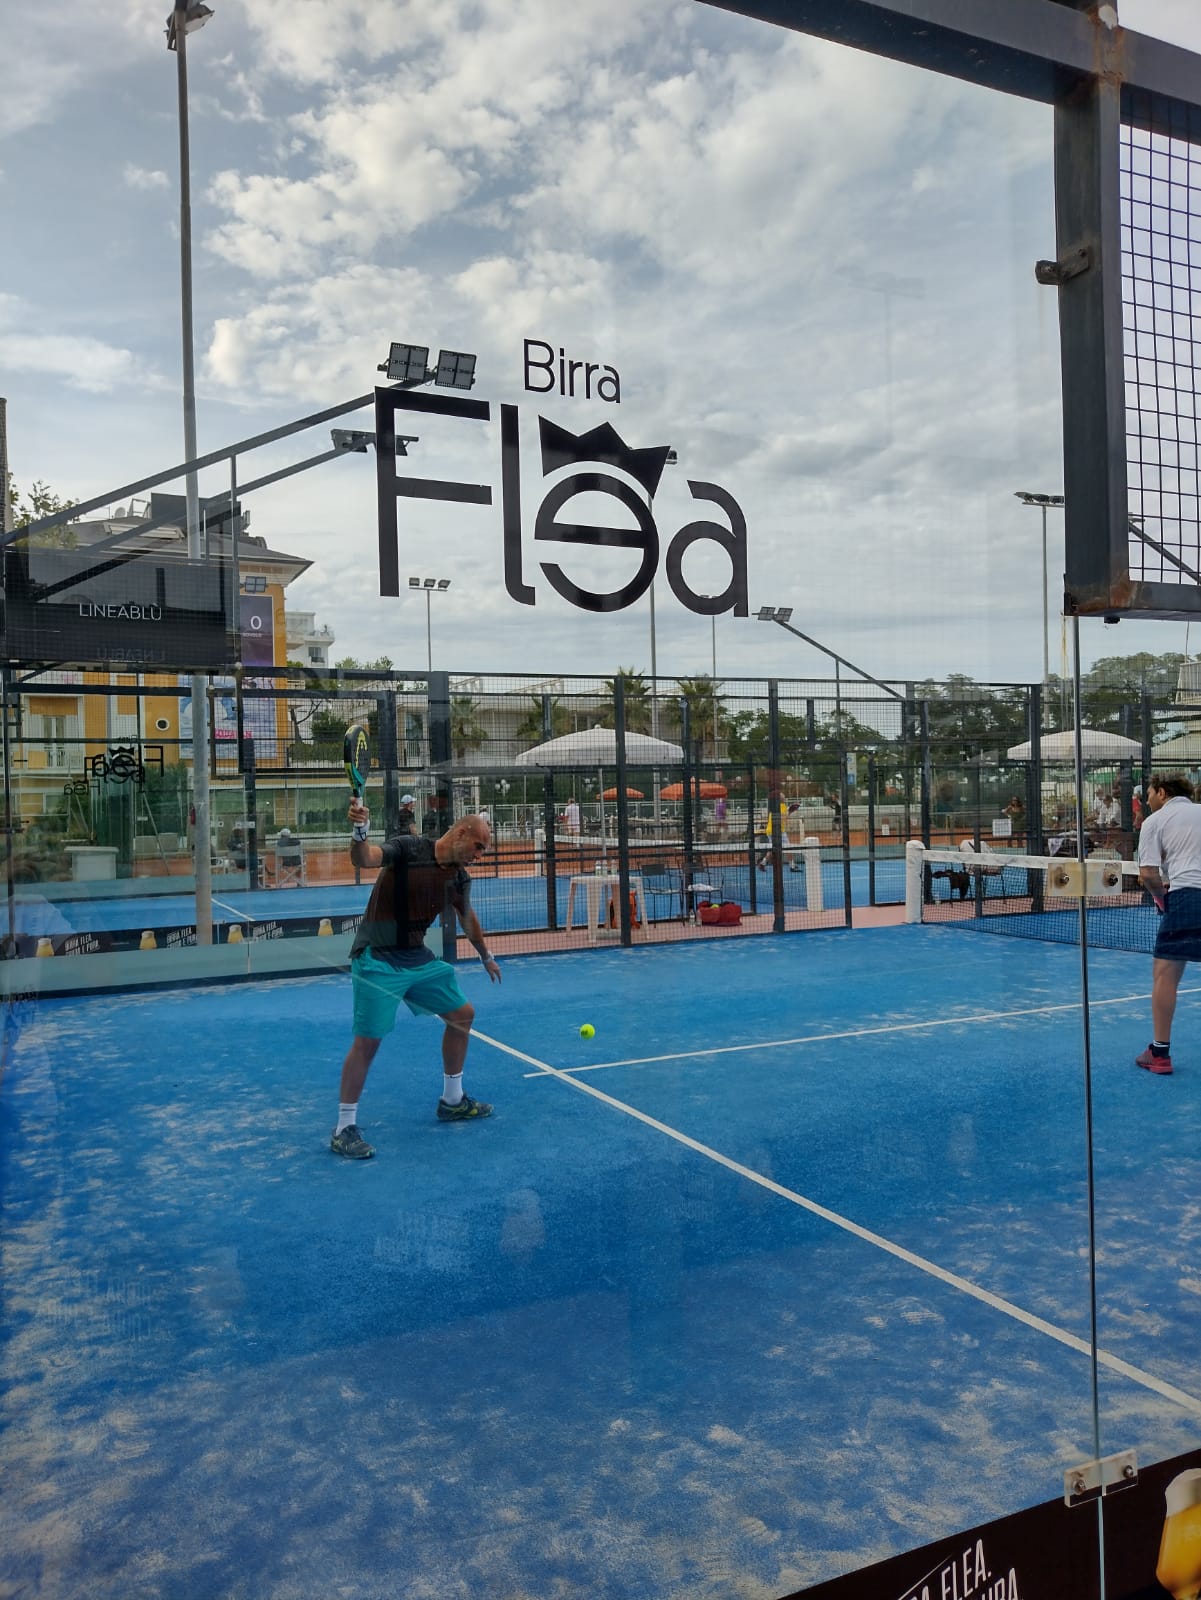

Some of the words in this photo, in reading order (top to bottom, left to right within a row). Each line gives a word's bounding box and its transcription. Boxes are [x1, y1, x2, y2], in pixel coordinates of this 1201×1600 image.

[524, 338, 620, 403] Birra
[375, 386, 749, 617] Flea
[79, 602, 162, 621] LINEABLÙ
